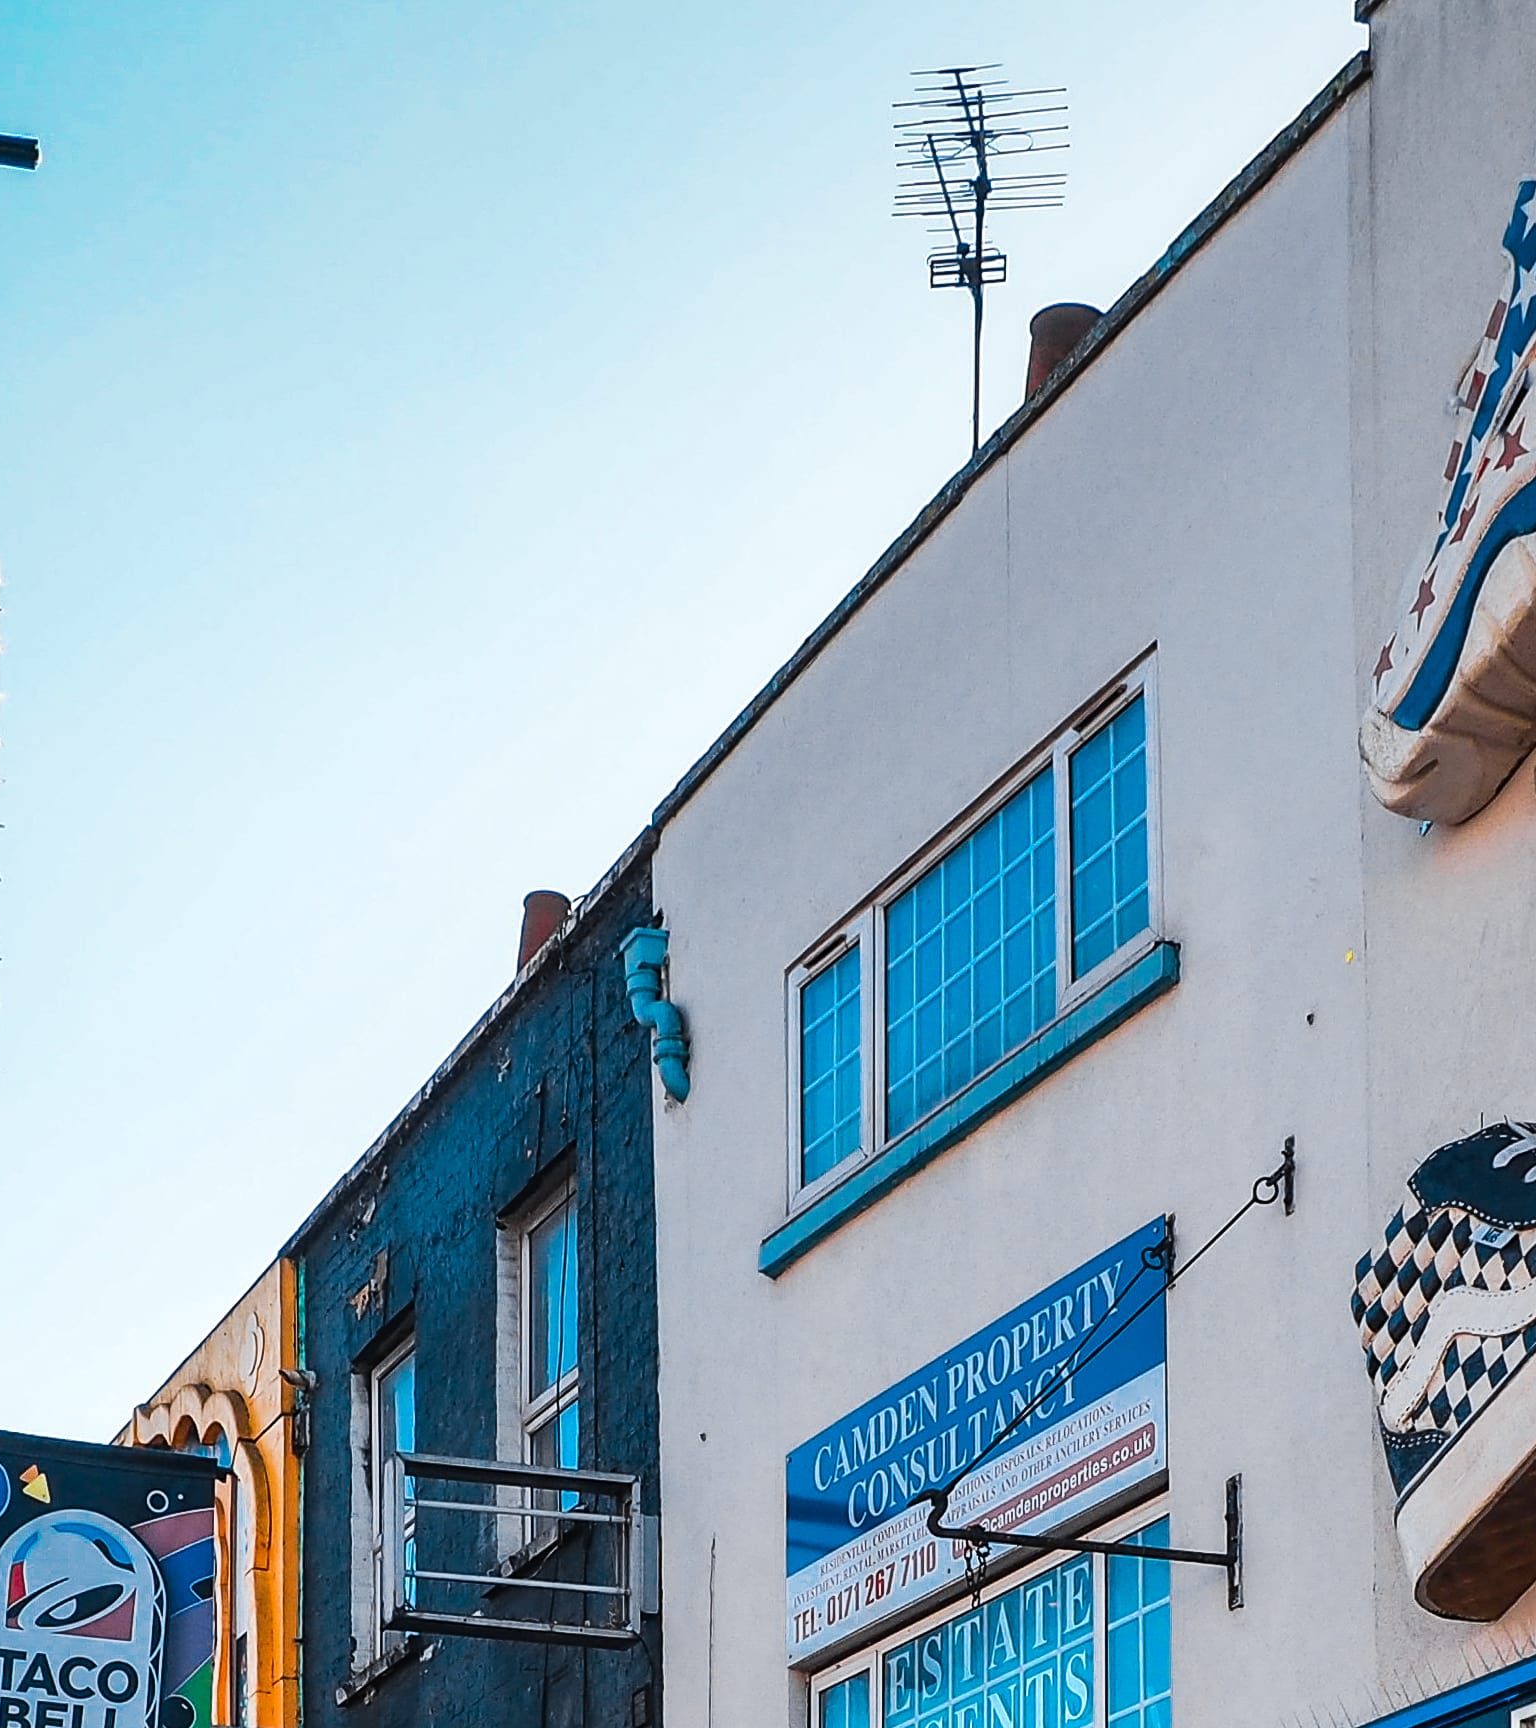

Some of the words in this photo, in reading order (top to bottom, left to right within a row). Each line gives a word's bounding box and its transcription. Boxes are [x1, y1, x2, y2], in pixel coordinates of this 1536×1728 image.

[813, 1376, 939, 1492] CAMDEN
[945, 1259, 1125, 1416] PROPERTY
[847, 1350, 1082, 1530] CONSULTANCY
[1021, 1456, 1053, 1481] OTHER
[1103, 1400, 1152, 1437] SERVICES
[793, 1607, 823, 1644] TEL:
[826, 1582, 861, 1627] 0171
[864, 1561, 897, 1607] 267
[900, 1540, 938, 1588] 7110
[886, 1561, 1092, 1719] ESTATE
